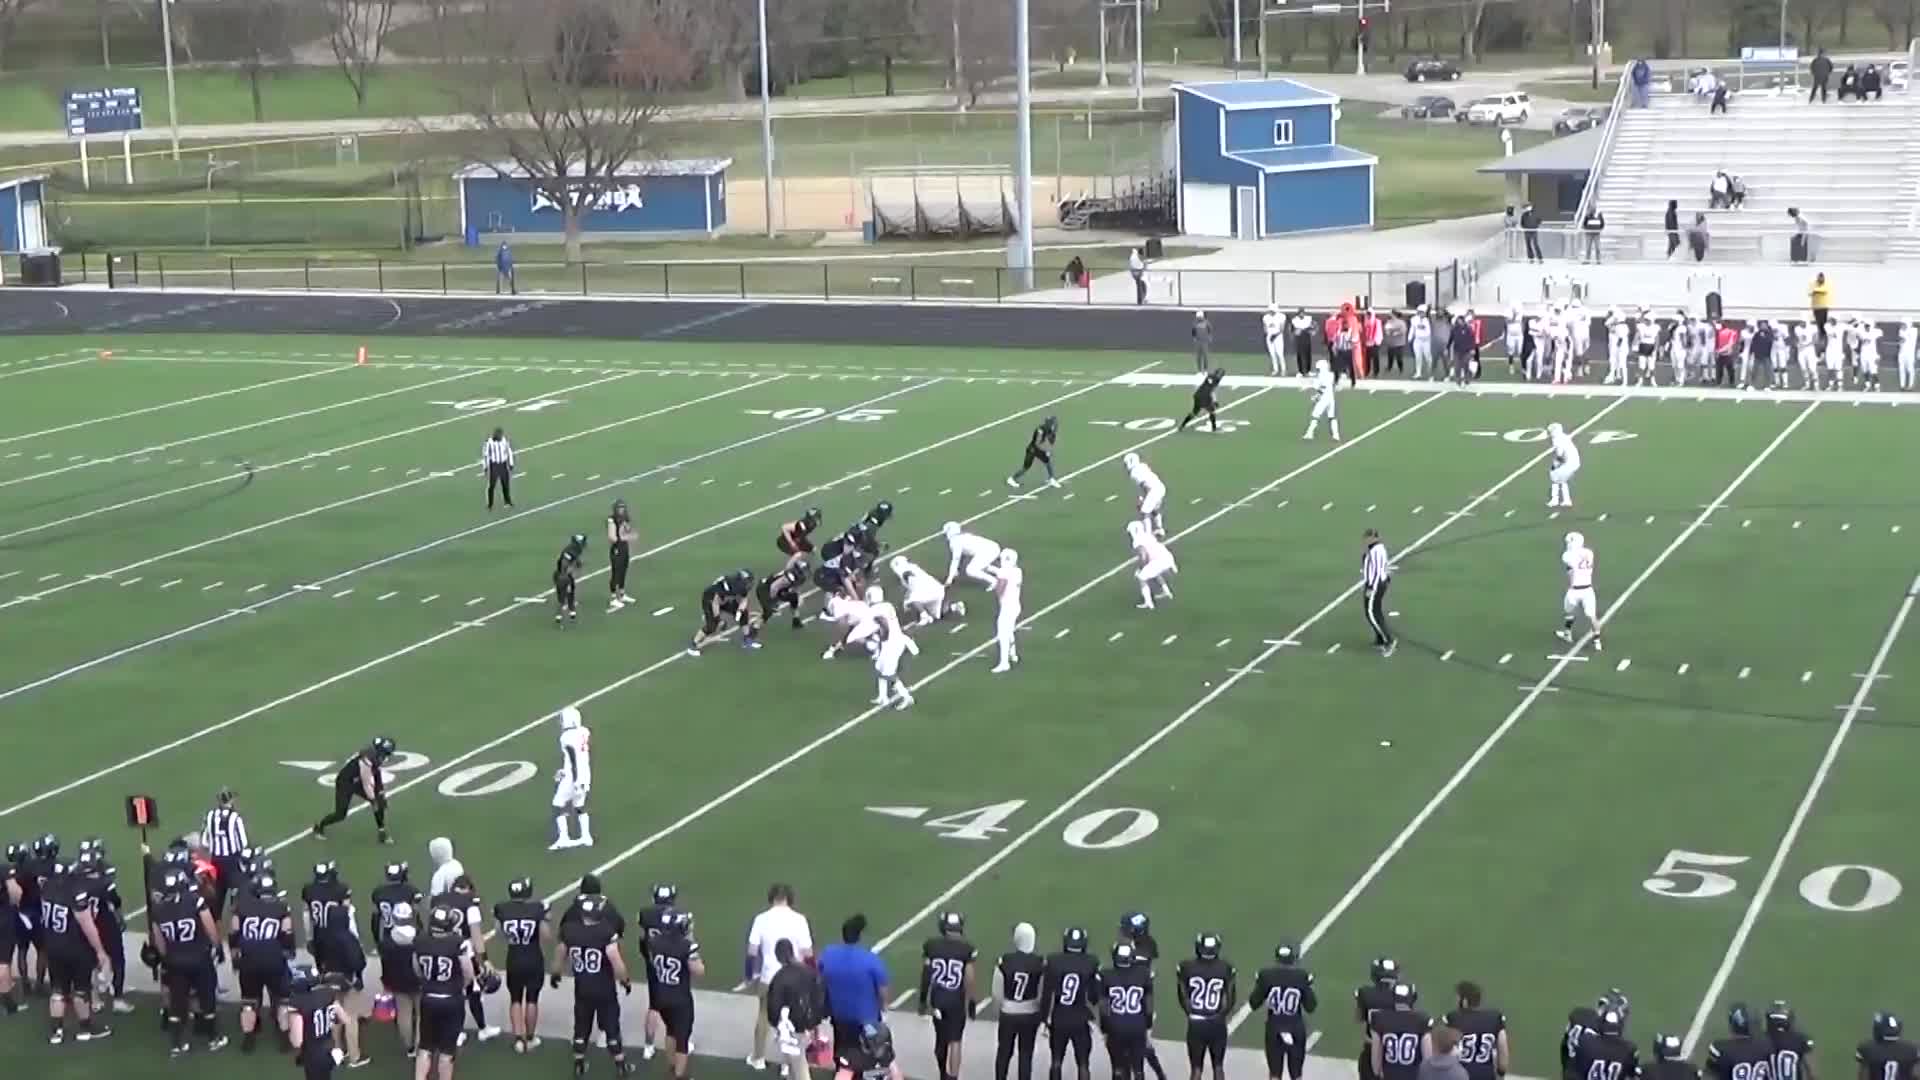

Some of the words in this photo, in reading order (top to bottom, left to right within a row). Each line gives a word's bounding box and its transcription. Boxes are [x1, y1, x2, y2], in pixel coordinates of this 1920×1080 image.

[133, 796, 148, 824] 1
[923, 798, 1160, 850] 40
[1642, 848, 1903, 912] 50
[931, 958, 964, 990] 25
[1013, 972, 1029, 1000] 7
[1060, 973, 1080, 1005] 9
[1109, 986, 1144, 1014] 20
[1188, 976, 1224, 1010] 26
[1267, 986, 1301, 1016] 40
